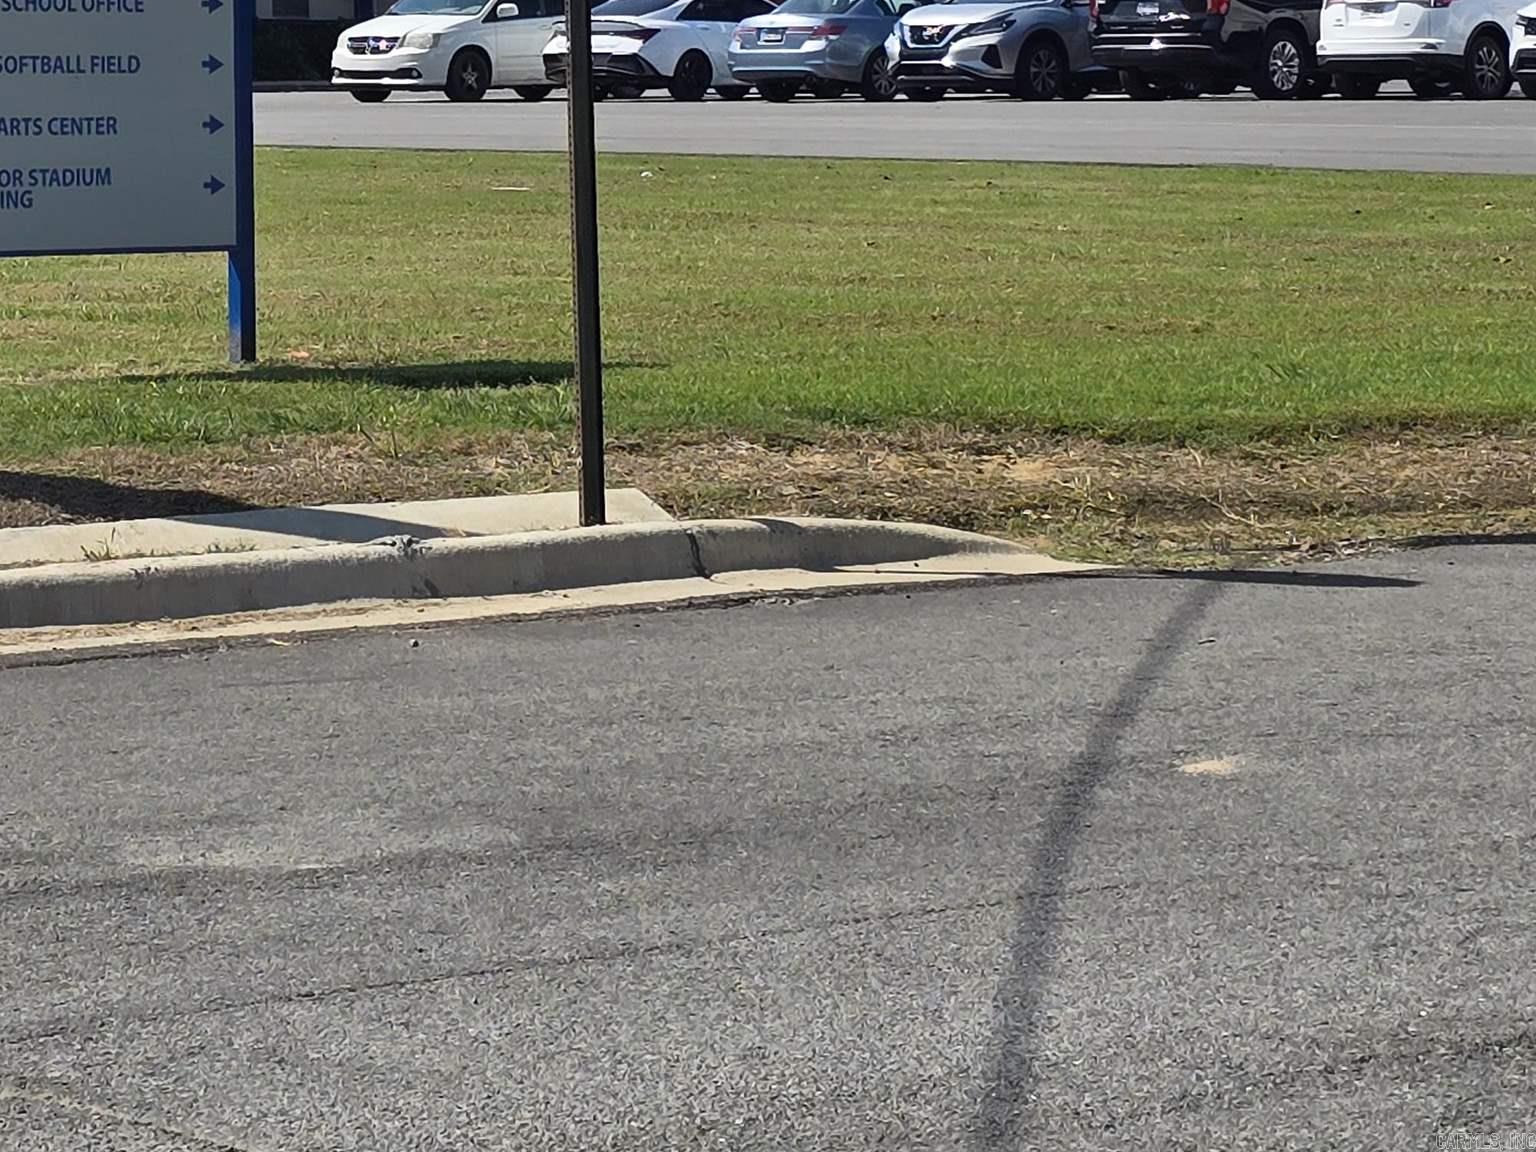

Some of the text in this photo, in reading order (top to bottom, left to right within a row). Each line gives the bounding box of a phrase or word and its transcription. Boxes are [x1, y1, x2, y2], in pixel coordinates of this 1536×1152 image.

[90, 55, 141, 74] FIELD
[47, 116, 118, 135] CENTER
[28, 168, 112, 187] STADIUM
